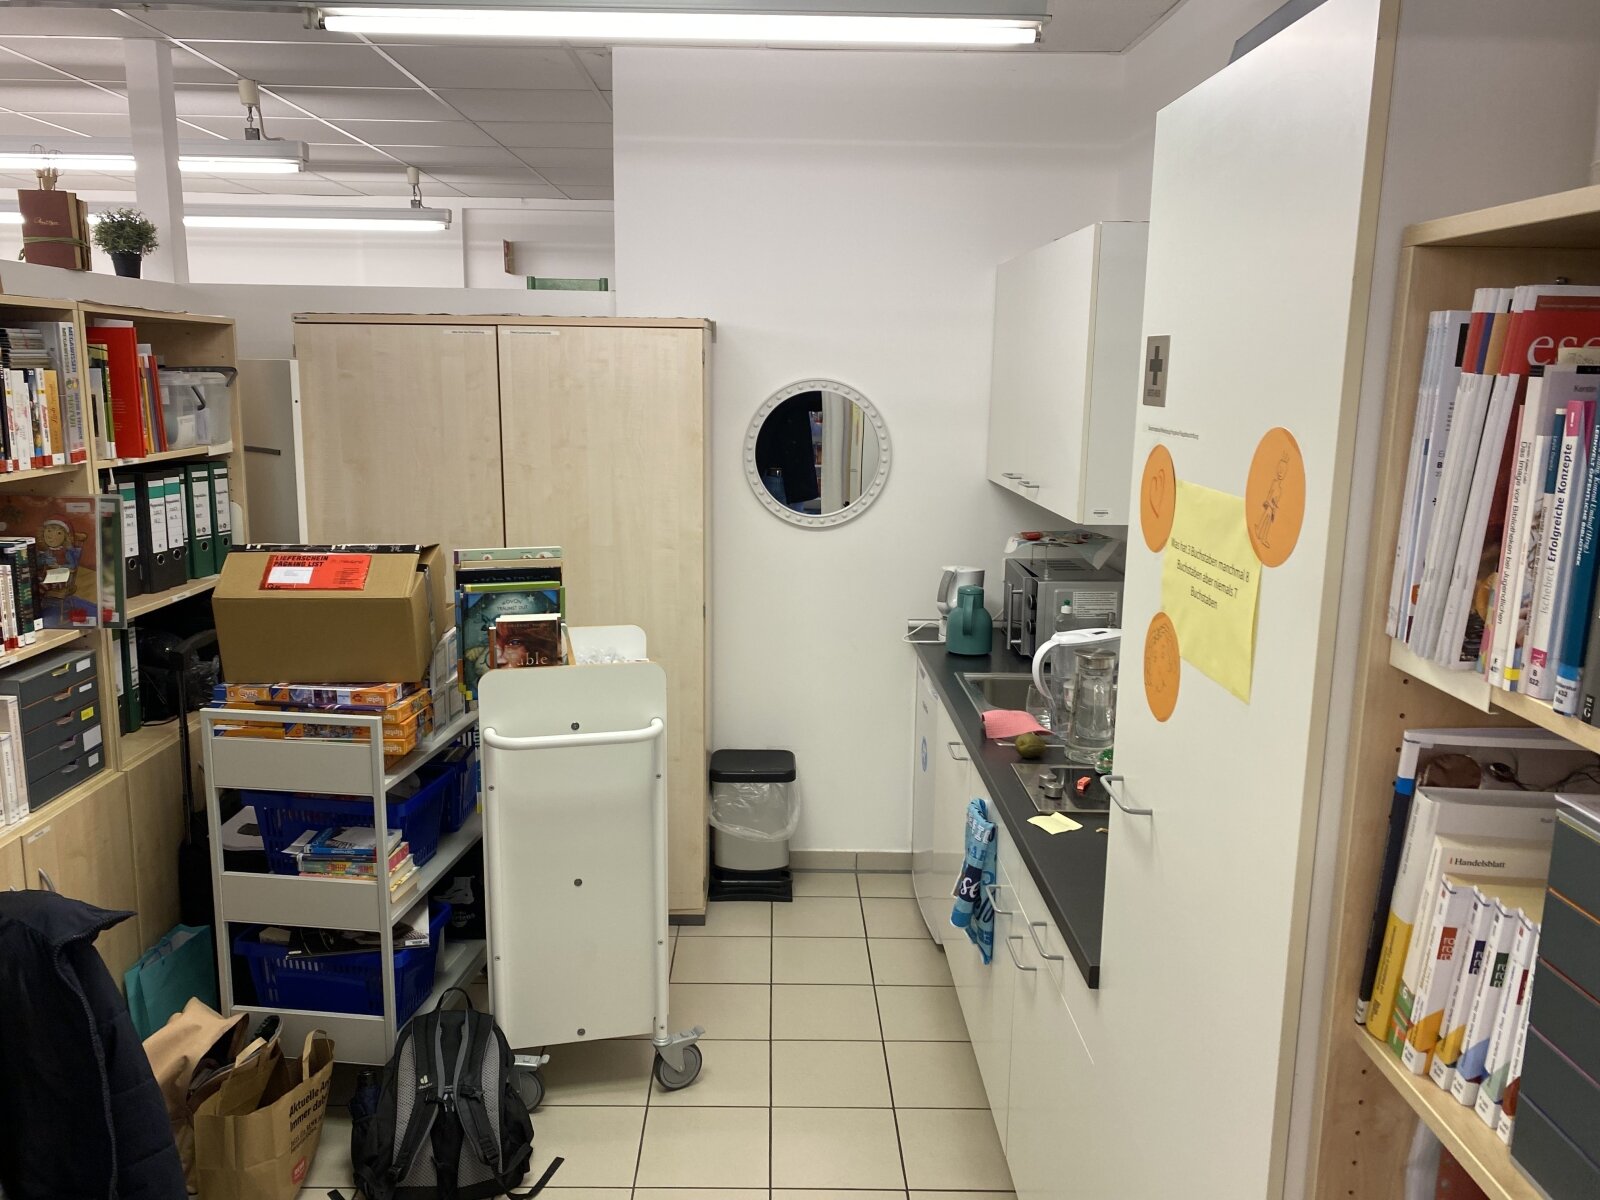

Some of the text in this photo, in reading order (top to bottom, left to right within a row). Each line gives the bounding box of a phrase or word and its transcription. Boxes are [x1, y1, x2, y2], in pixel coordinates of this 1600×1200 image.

[1520, 441, 1528, 457] Das
[1590, 425, 1600, 466] LERNWELT
[1514, 460, 1525, 486] Image
[1547, 497, 1565, 563] Erfolgreiche
[1557, 443, 1573, 494] Konzepte
[1506, 505, 1519, 554] Bibliotheken
[1576, 522, 1586, 566] BIBLIOTHEK
[1177, 559, 1202, 580] Buchstaben
[1203, 573, 1214, 586] aber
[1214, 579, 1234, 598] niemals
[1191, 546, 1217, 568] Buchstaben
[1219, 561, 1246, 581] manchmal
[1504, 556, 1512, 570] bei
[1190, 585, 1218, 610] Buchstaben
[1497, 571, 1510, 625] Jugendlichen
[1454, 857, 1506, 869] Handelsblatt
[289, 1088, 319, 1117] Aktuelle
